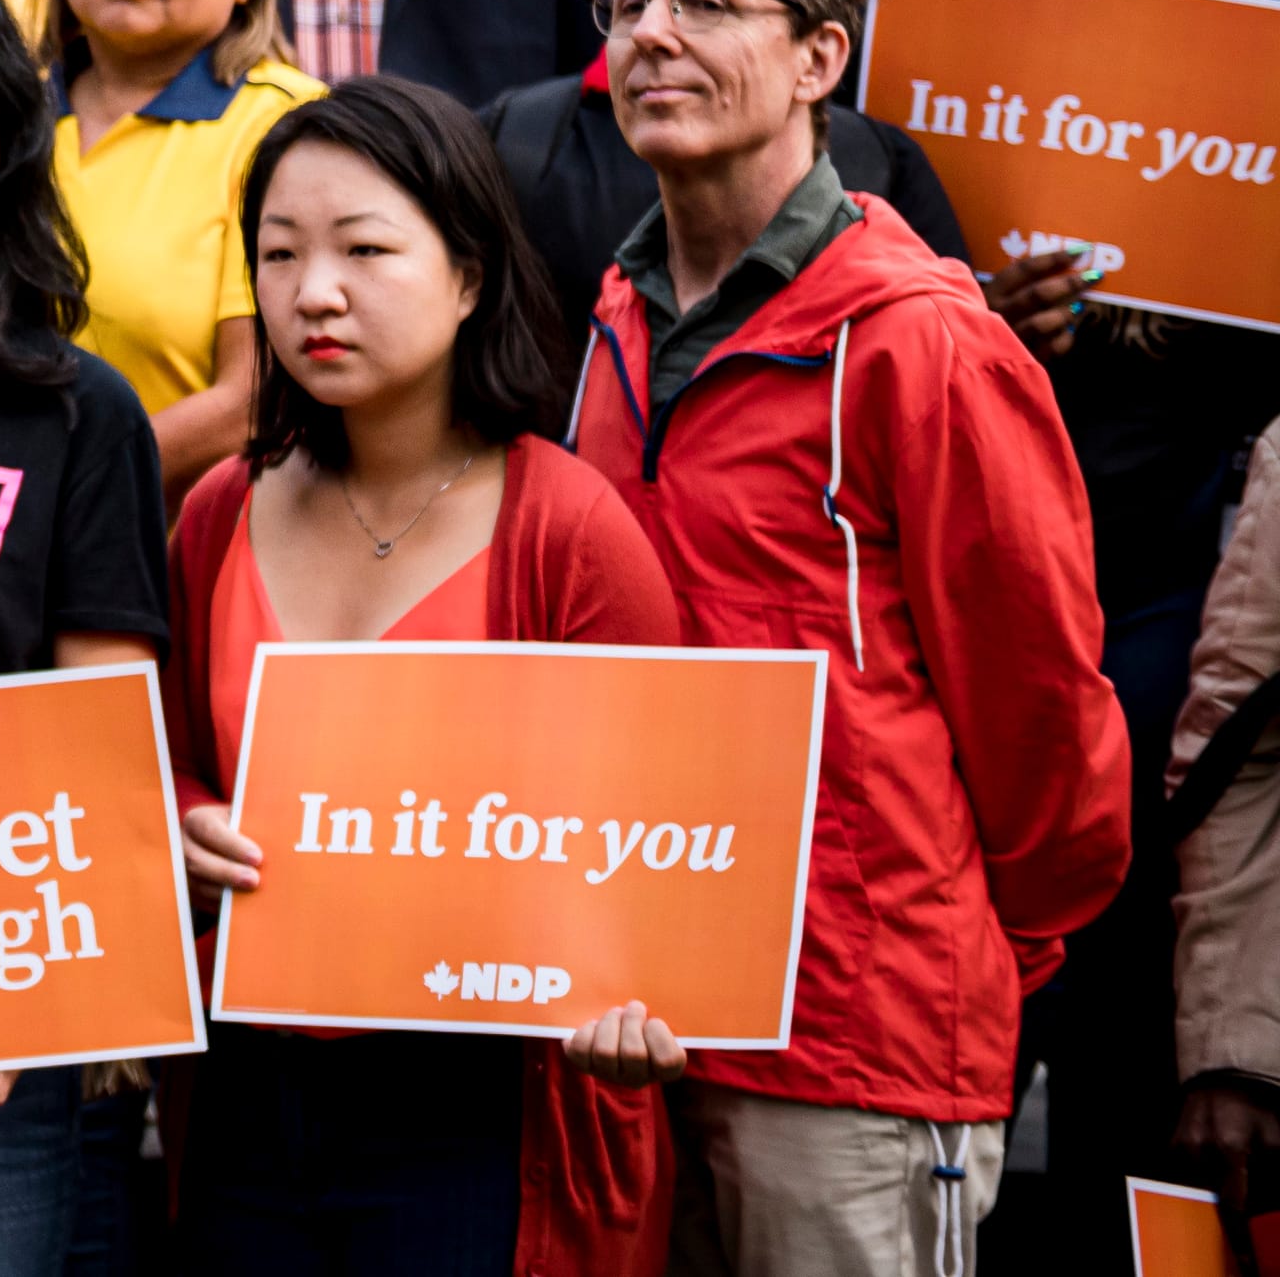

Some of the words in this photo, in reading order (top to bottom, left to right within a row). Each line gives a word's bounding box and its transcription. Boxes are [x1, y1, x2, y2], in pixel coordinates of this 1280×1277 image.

[906, 78, 968, 138] In
[979, 85, 1029, 145] it
[1040, 94, 1145, 162] for
[1141, 128, 1277, 185] you
[294, 793, 374, 854] In
[390, 789, 448, 857] it
[464, 792, 583, 863] for
[585, 819, 736, 885] you
[460, 961, 572, 1005] NDP
